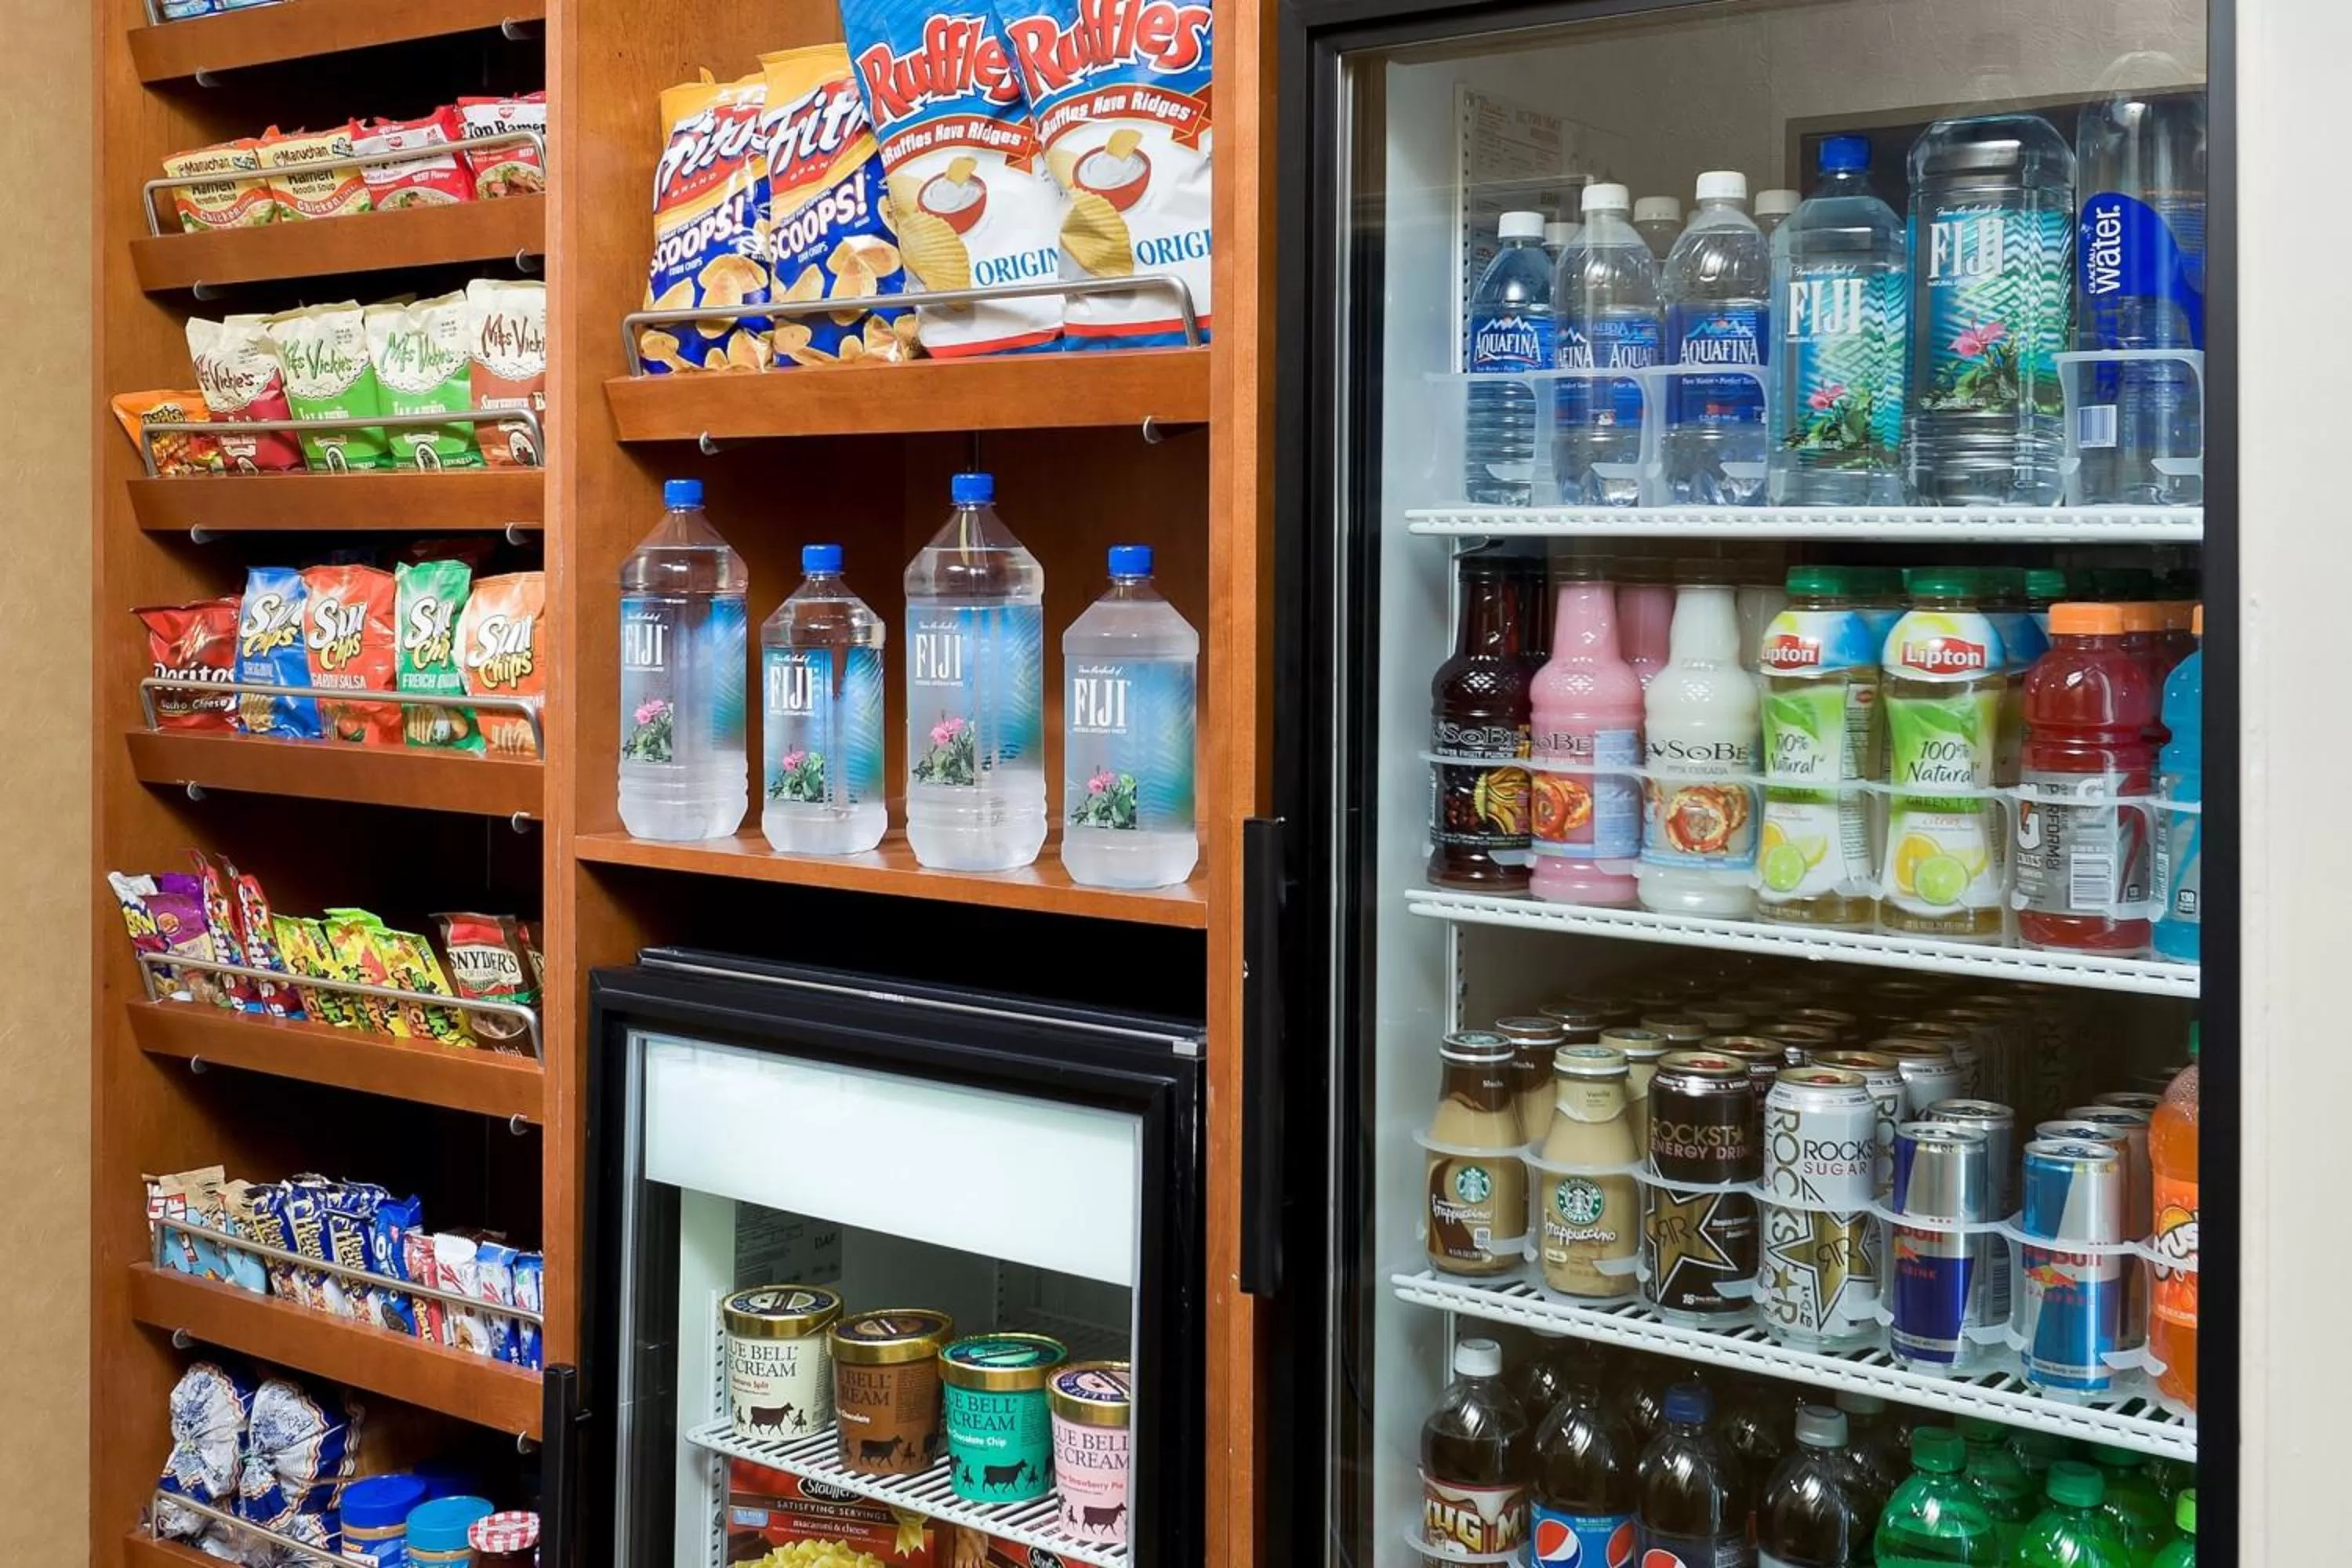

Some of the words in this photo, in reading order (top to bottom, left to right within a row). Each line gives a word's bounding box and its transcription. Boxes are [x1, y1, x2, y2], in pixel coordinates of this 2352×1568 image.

[1007, 0, 1211, 103] Ruffles
[856, 14, 1021, 128] Ruffles
[1093, 95, 1127, 115] Have
[1131, 91, 1192, 122] Ridges
[762, 86, 863, 176] Frit
[935, 123, 964, 142] Have
[967, 121, 1022, 147] Ridges
[296, 198, 343, 215] Chicken
[770, 172, 868, 261] SCOOPS!
[1136, 228, 1212, 266] ORIGI
[1928, 219, 2004, 278] FIJI
[975, 245, 1059, 286] ORIGIN
[1788, 278, 1864, 335] FIJI
[1474, 330, 1541, 365] AQUAFINA
[1679, 336, 1760, 366] AQUAFINA
[625, 623, 664, 666] FIJI
[915, 633, 962, 679] FIJI
[1905, 641, 1982, 673] Lipton
[338, 673, 368, 689] SALSA
[479, 651, 534, 690] Chips
[770, 666, 814, 710] FIJI
[1073, 678, 1127, 728] FIJI
[1905, 760, 1976, 784] Natural
[449, 949, 518, 975] SNYDER'S
[1803, 1139, 1874, 1162] ROCKS
[1803, 1161, 1867, 1175] SUGAR
[735, 1361, 797, 1378] CREAM
[750, 1345, 795, 1363] BELL
[967, 1396, 1013, 1413] BELL
[953, 1413, 1015, 1432] CREAM
[986, 1436, 1007, 1449] Chip
[777, 1499, 836, 1516] SATISFYING
